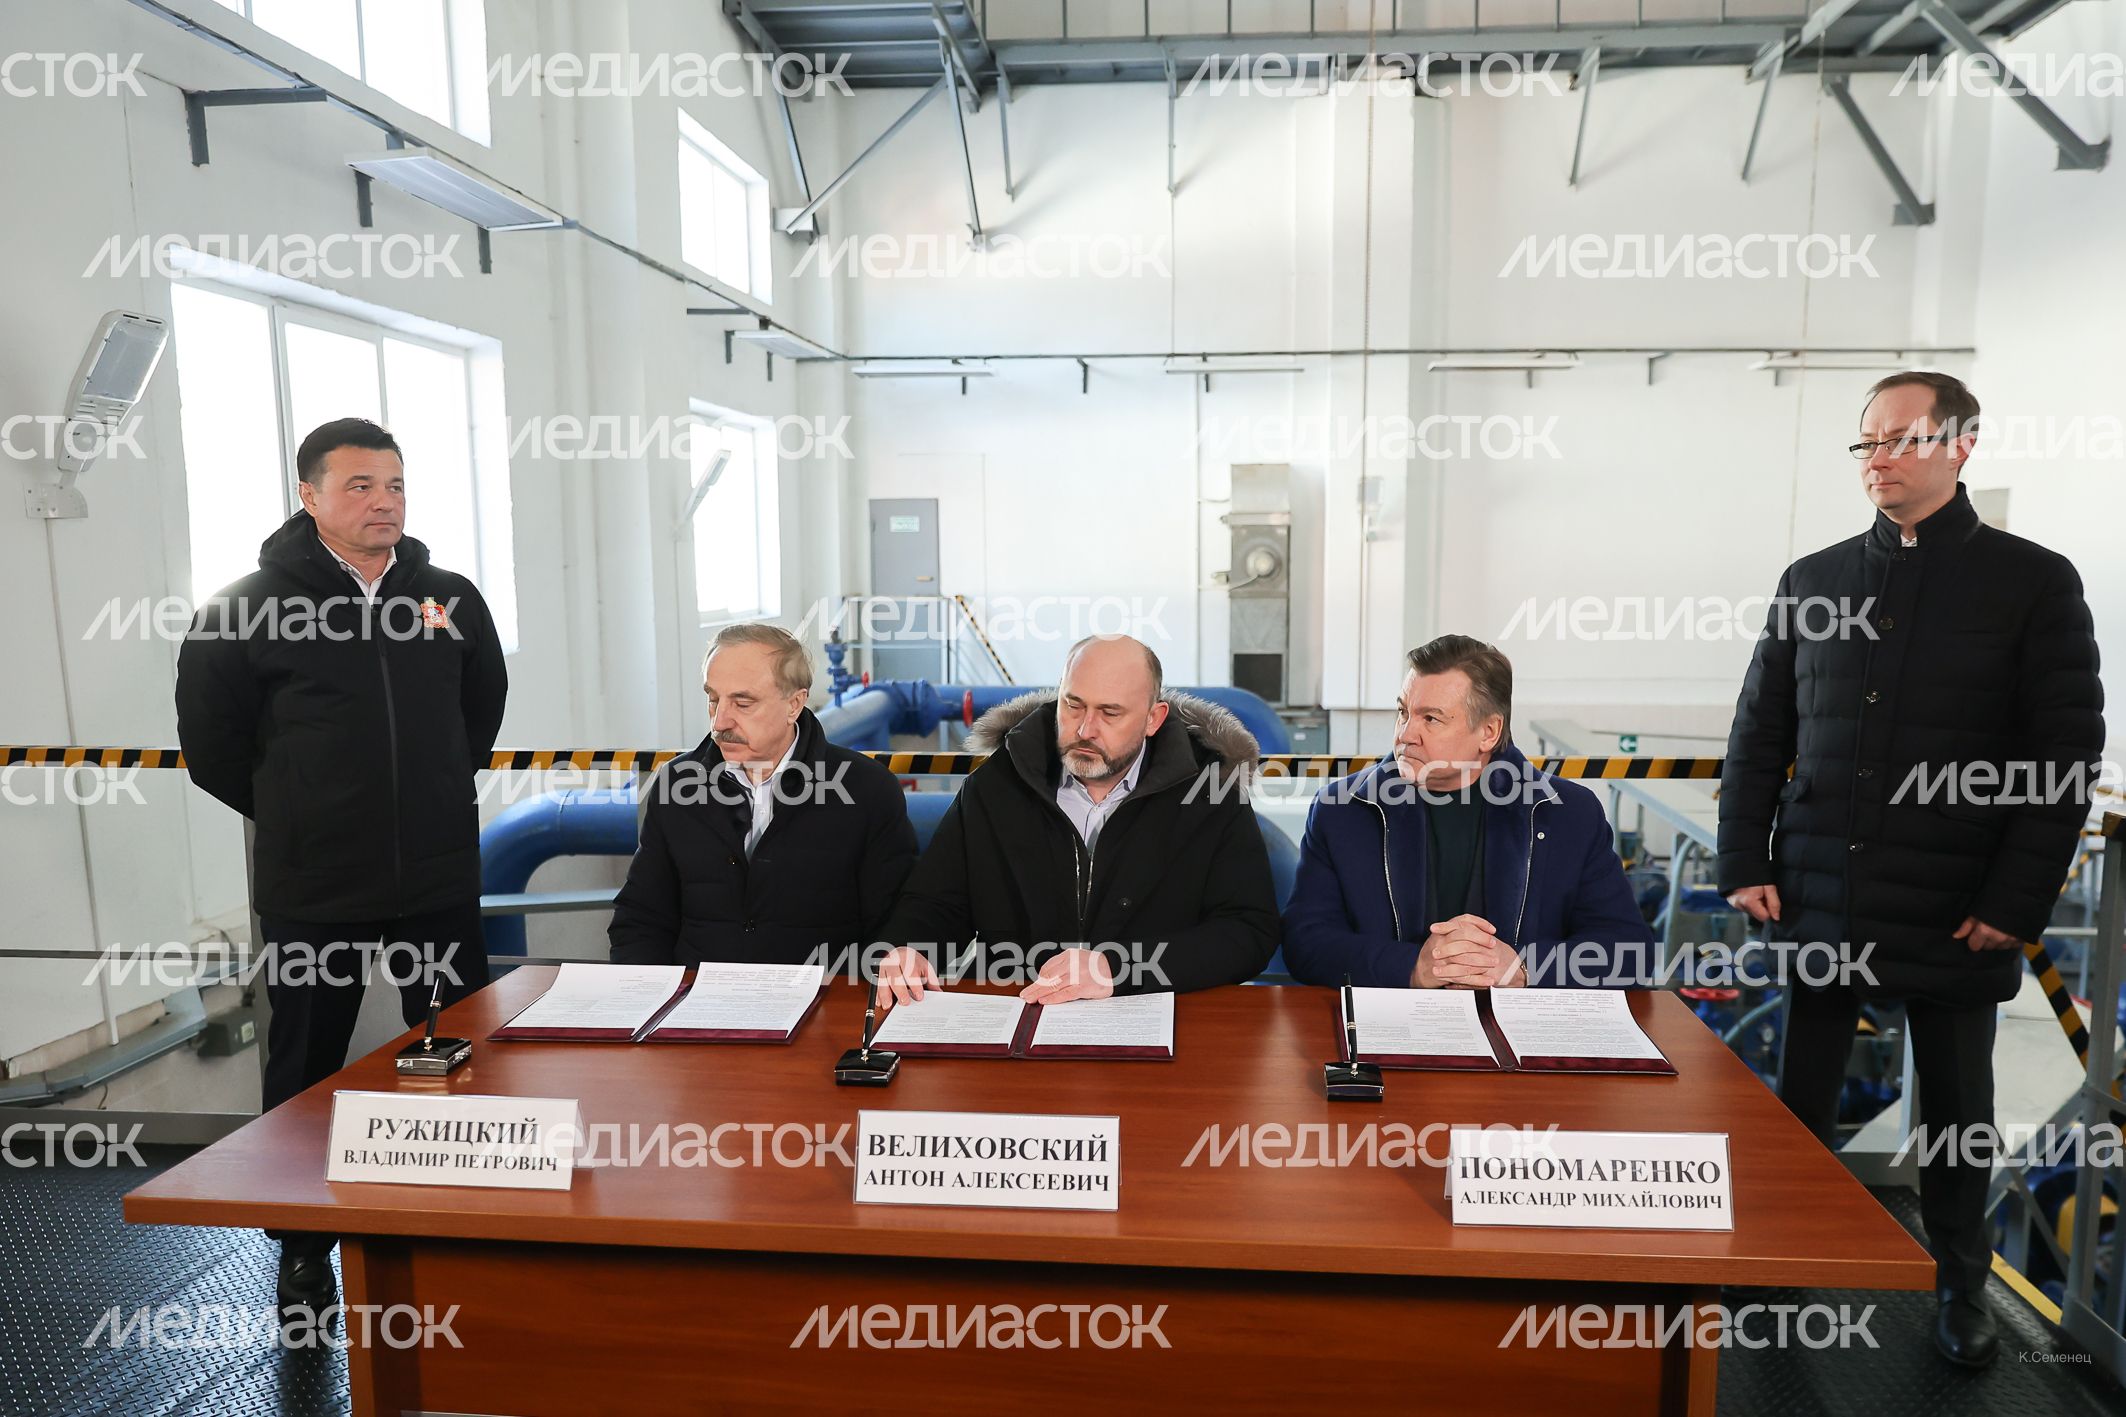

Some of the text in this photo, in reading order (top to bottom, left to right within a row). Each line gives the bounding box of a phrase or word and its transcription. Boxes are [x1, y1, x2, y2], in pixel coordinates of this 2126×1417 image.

[367, 1117, 539, 1147] РУЖИЦКИЙ
[344, 1149, 558, 1172] ВЛАДИМИР ПЕТРОВИЧ
[868, 1133, 1109, 1163] ВЕЛИХОВСКИЙ
[864, 1169, 1110, 1192] АНТОН АЛЕКСЕЕВИЧ
[1459, 1156, 1721, 1184] ПОНОМАРЕНКО
[1460, 1190, 1723, 1209] АЛЕКСАНДР МИХАЙЛОВИЧ
